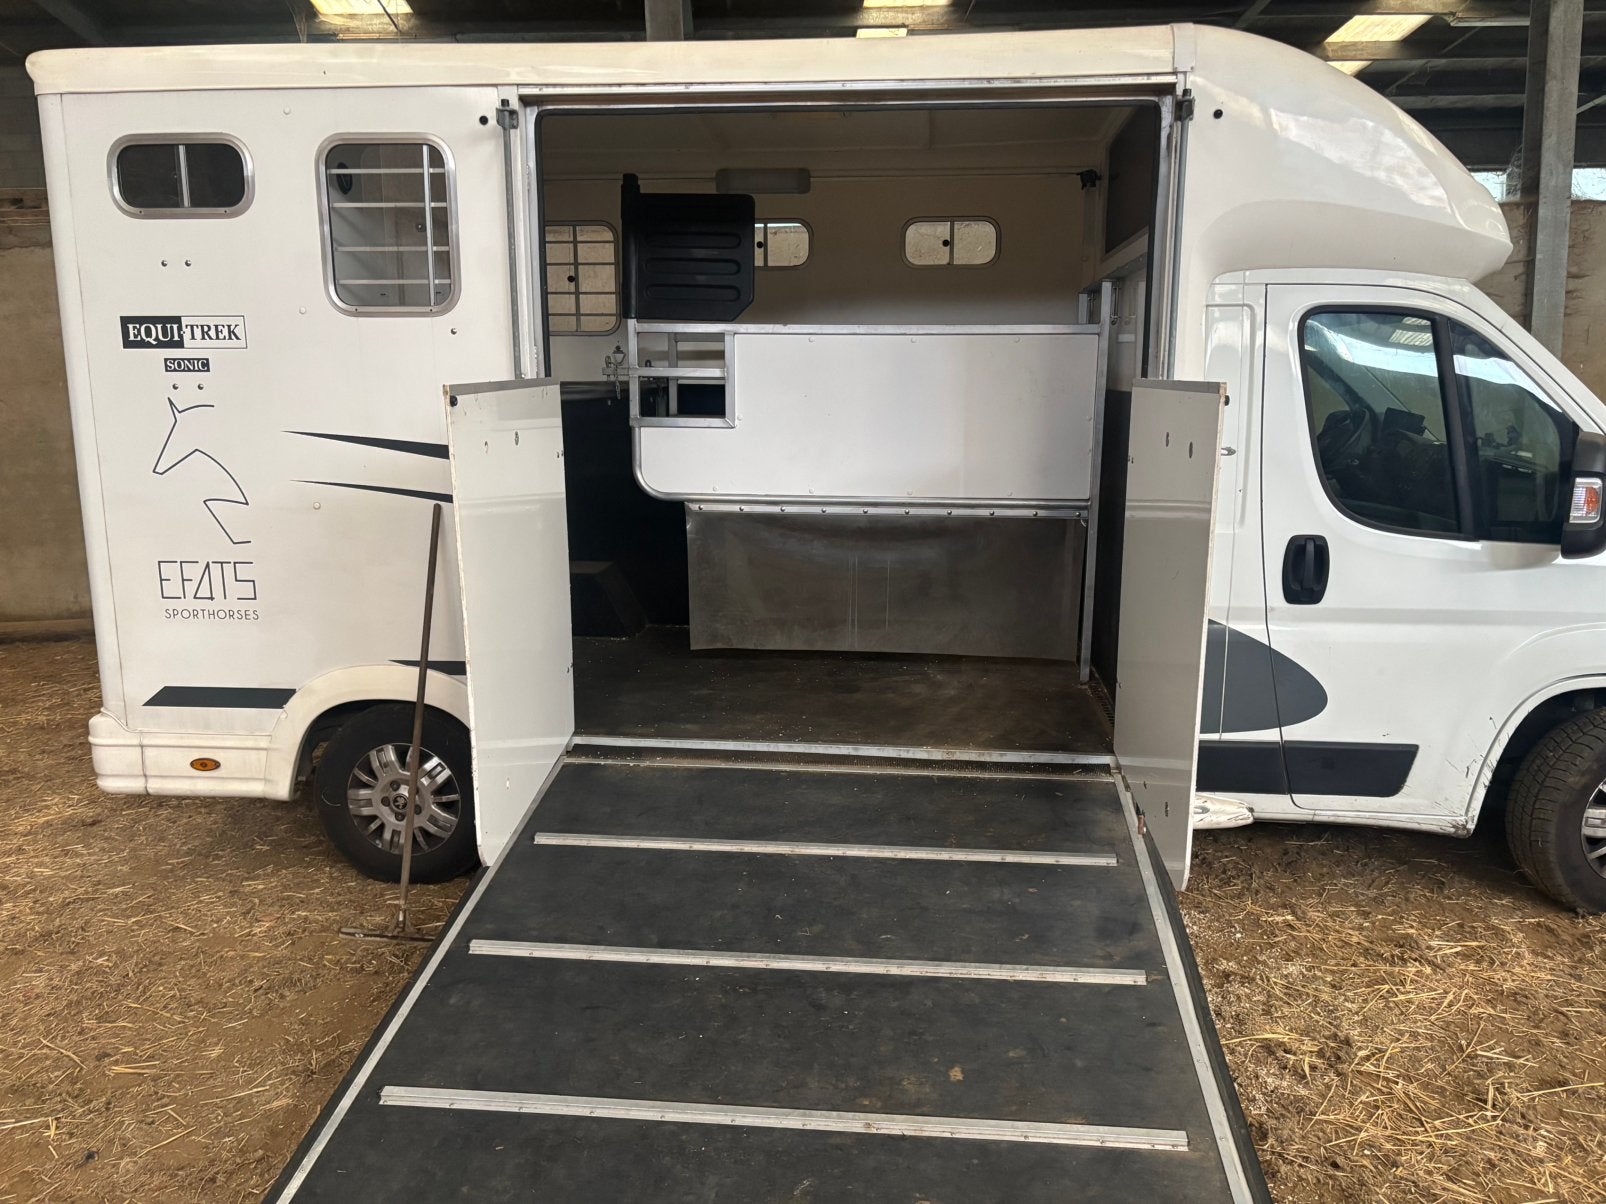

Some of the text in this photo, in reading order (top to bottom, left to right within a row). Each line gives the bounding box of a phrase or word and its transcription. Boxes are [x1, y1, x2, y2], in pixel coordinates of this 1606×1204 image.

[166, 359, 208, 371] SONIC
[157, 560, 258, 601] EFATS
[164, 608, 260, 621] SPORTHORSES
